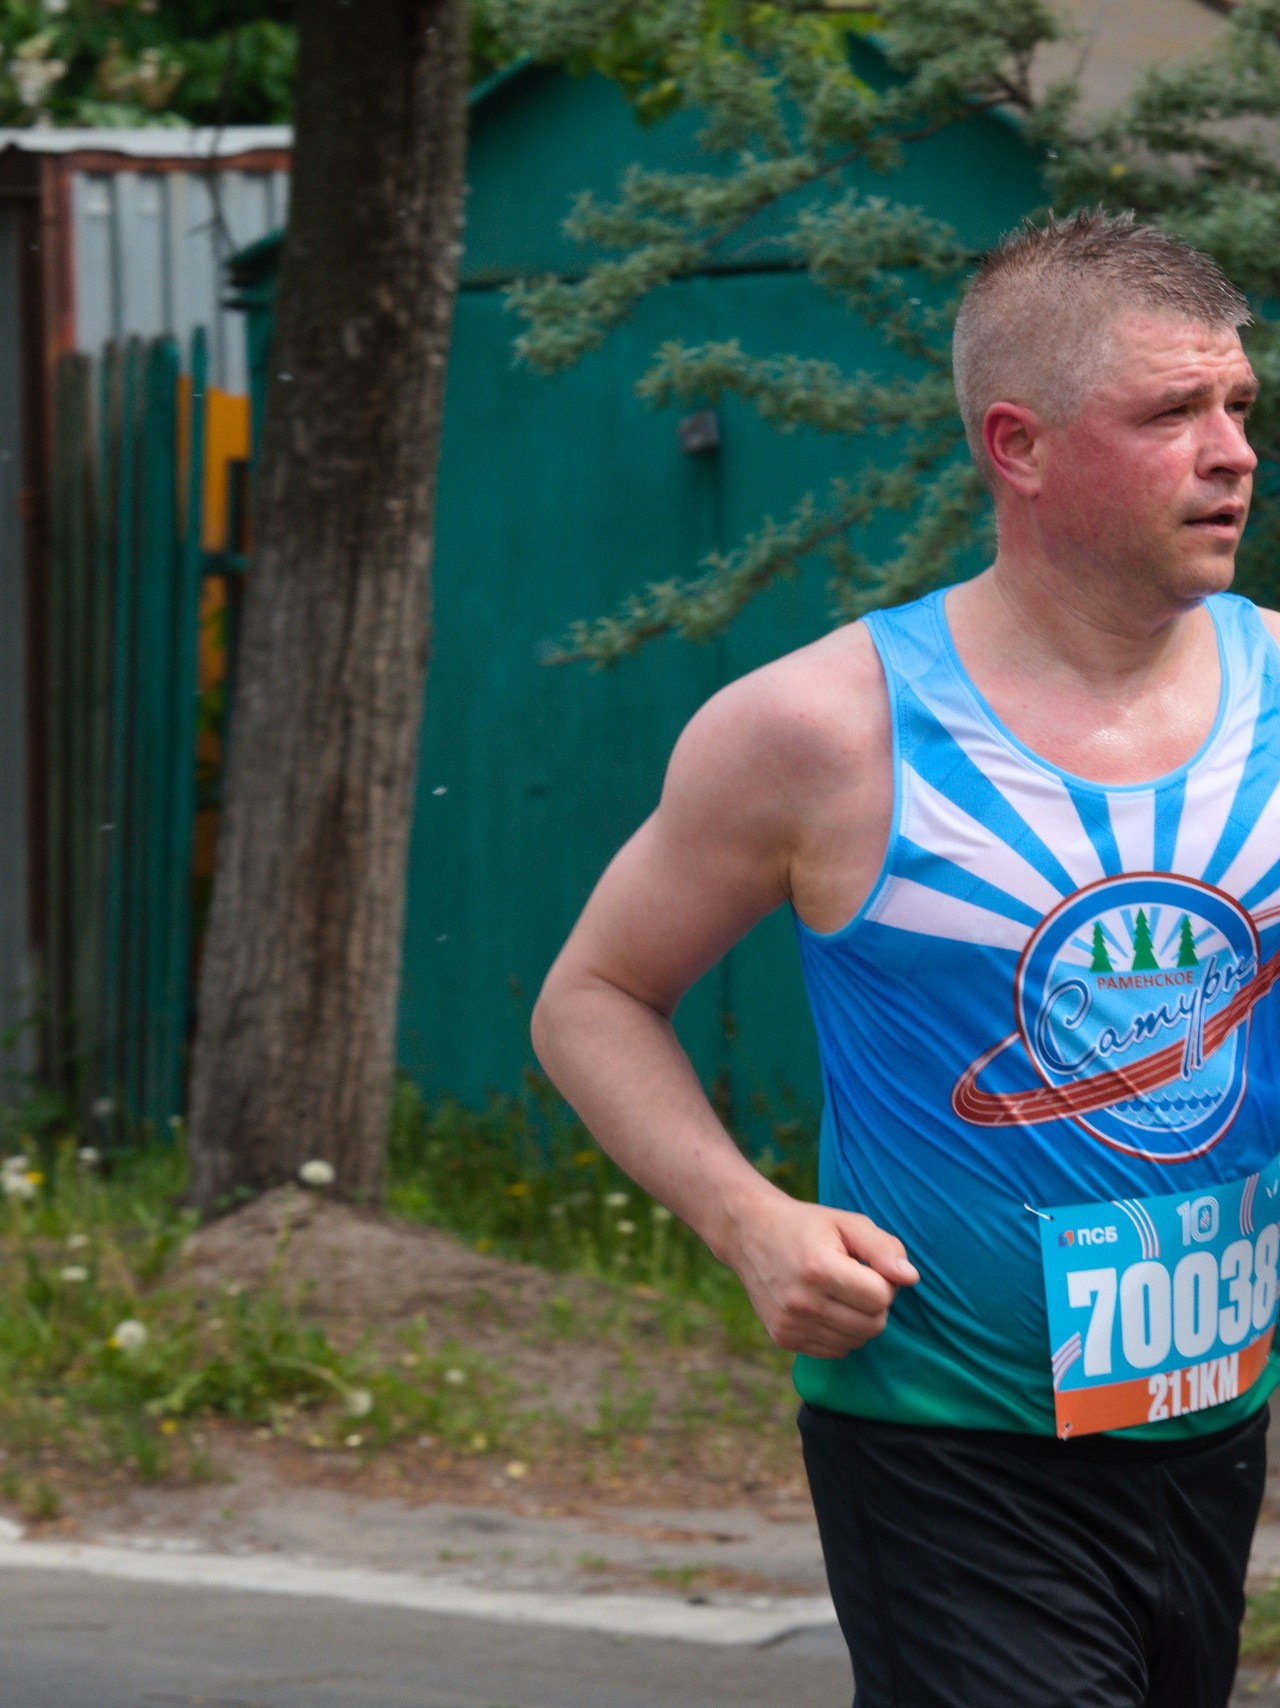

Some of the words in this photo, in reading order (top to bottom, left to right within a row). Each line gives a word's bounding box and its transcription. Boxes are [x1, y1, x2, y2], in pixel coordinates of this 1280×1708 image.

[1096, 969, 1195, 991] РАМЕНСКОЕ
[1035, 954, 1258, 1082] Сатурн
[1077, 1226, 1118, 1246] ПСБ
[1176, 1195, 1219, 1246] 10
[1066, 1223, 1279, 1377] 70038
